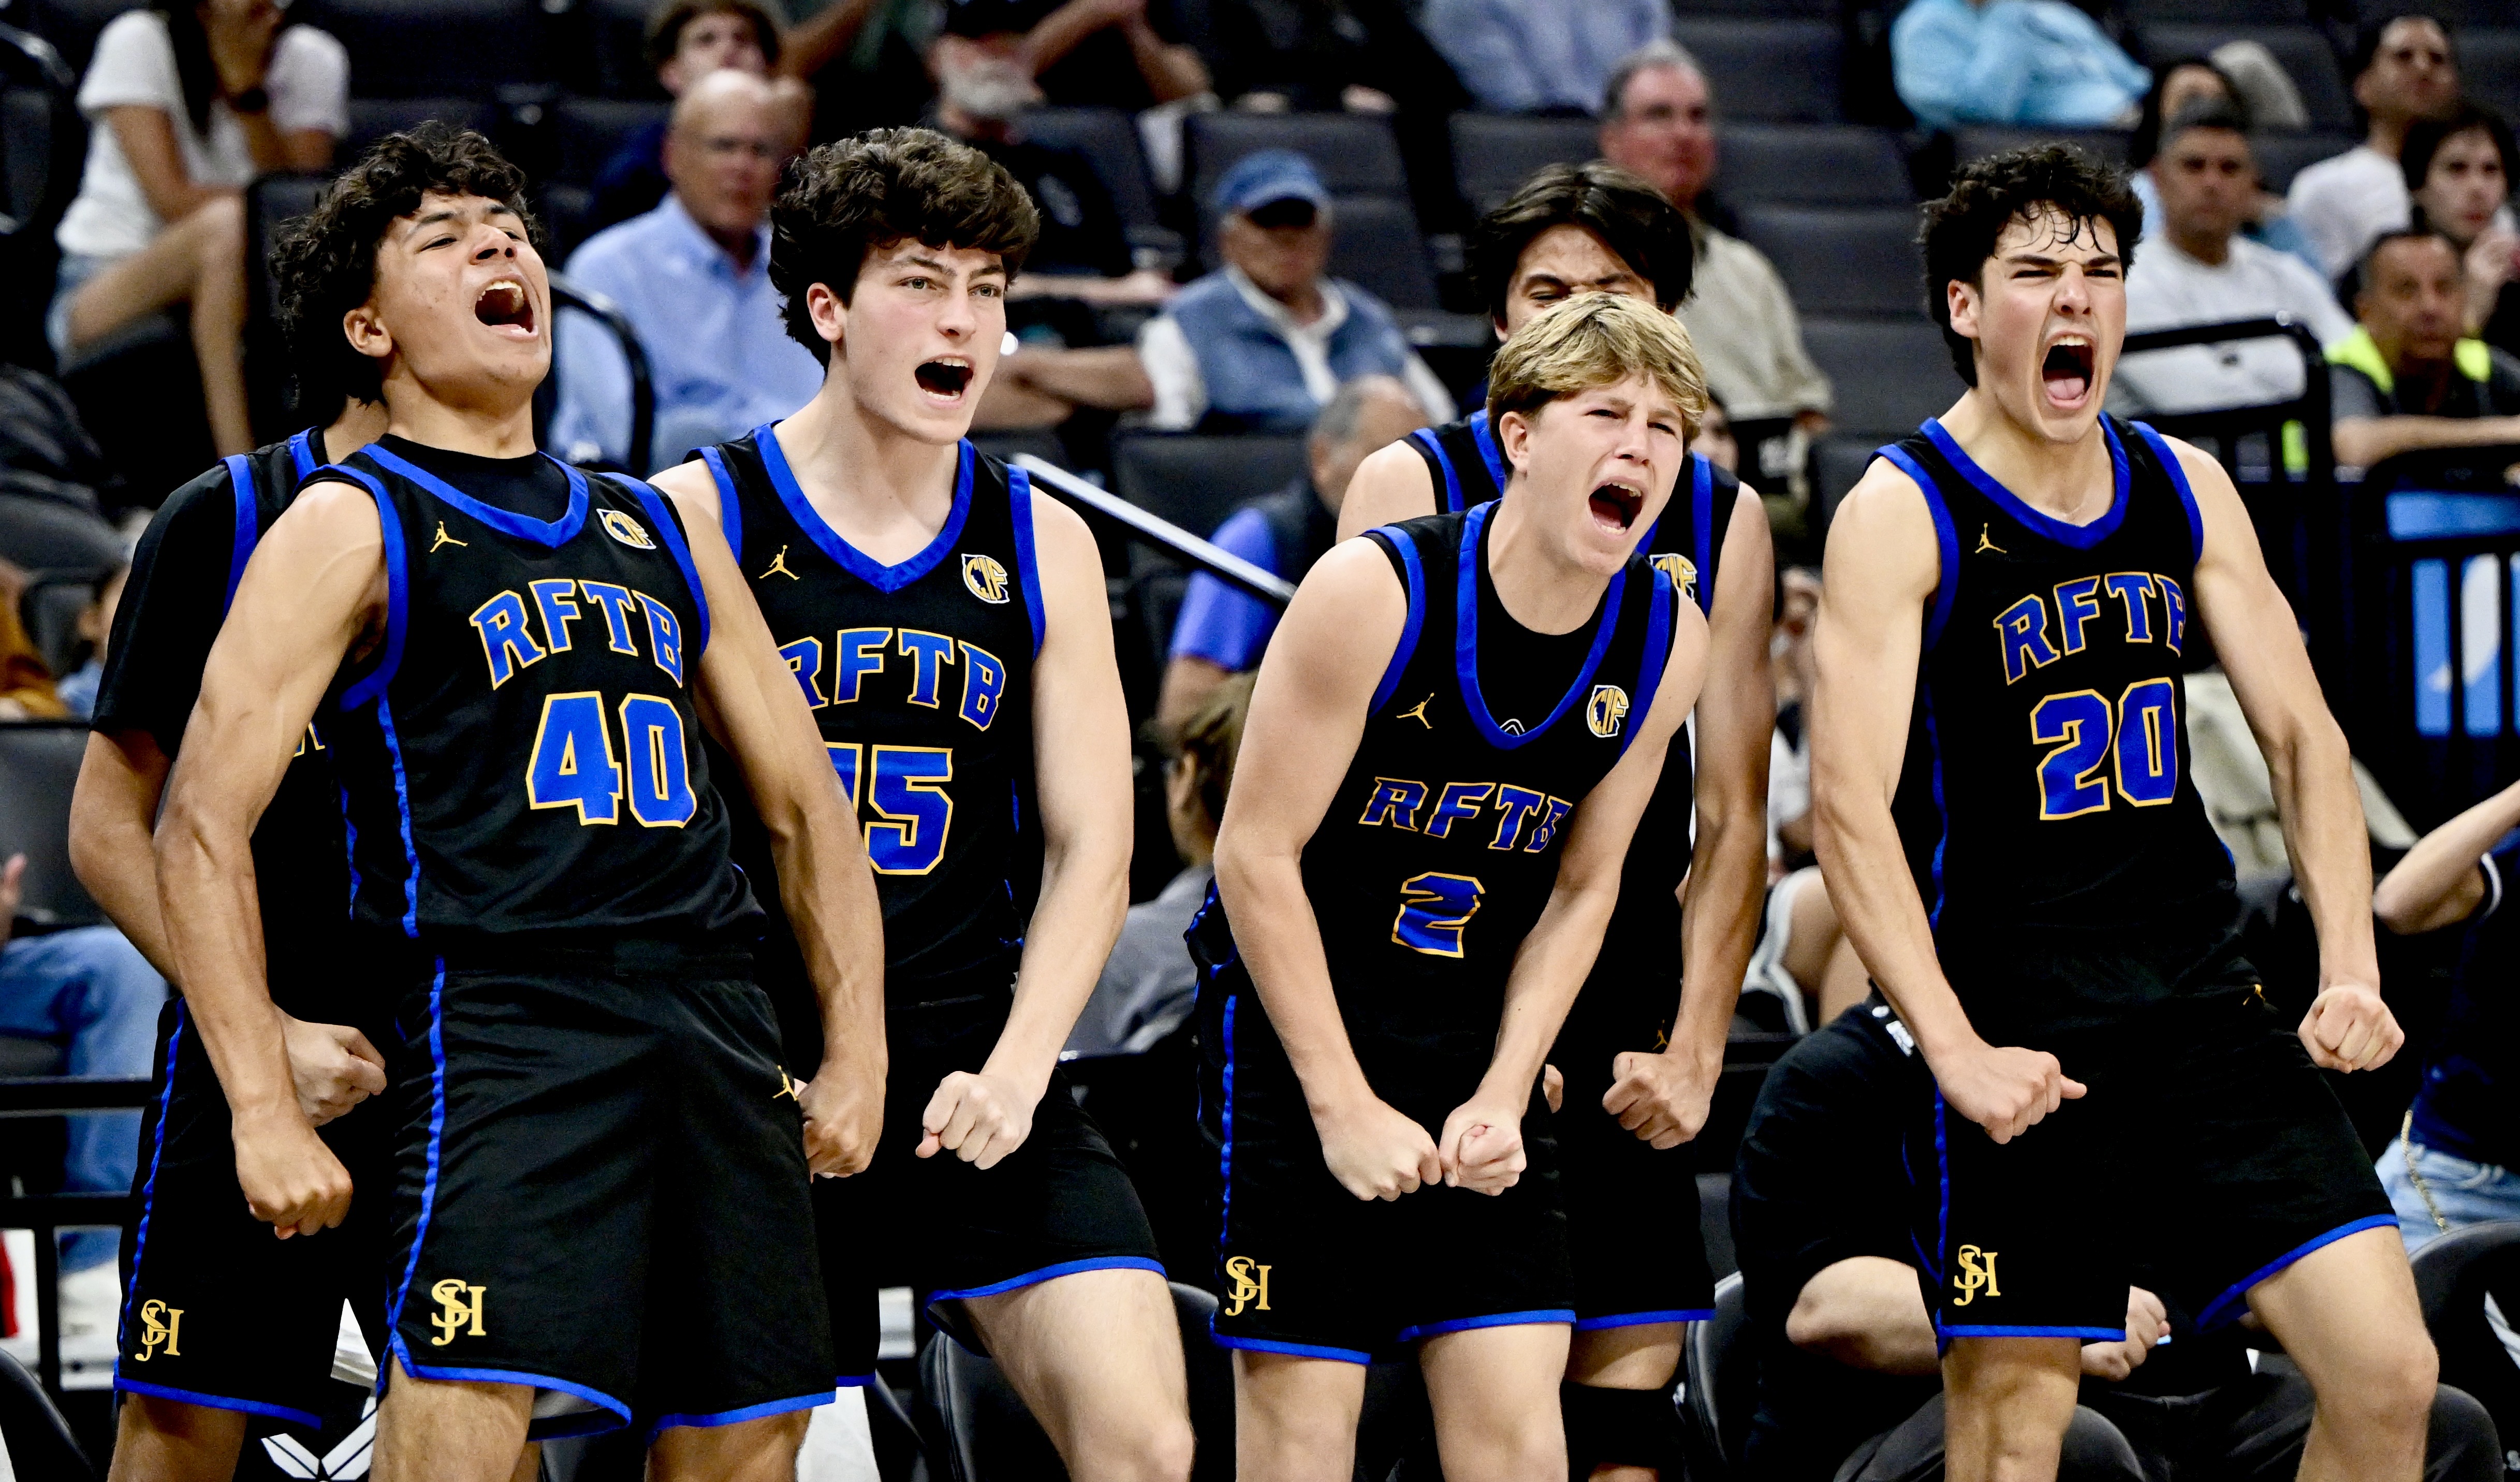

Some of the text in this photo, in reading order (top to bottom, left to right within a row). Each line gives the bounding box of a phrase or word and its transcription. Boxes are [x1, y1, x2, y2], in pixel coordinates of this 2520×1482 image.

[965, 556, 1007, 601] CIF
[469, 578, 683, 689] RFTB
[778, 627, 1006, 732] RFTB
[525, 691, 697, 828] 40
[1588, 686, 1628, 736] CIF
[2030, 676, 2178, 821] 20
[1391, 871, 1486, 959] 2
